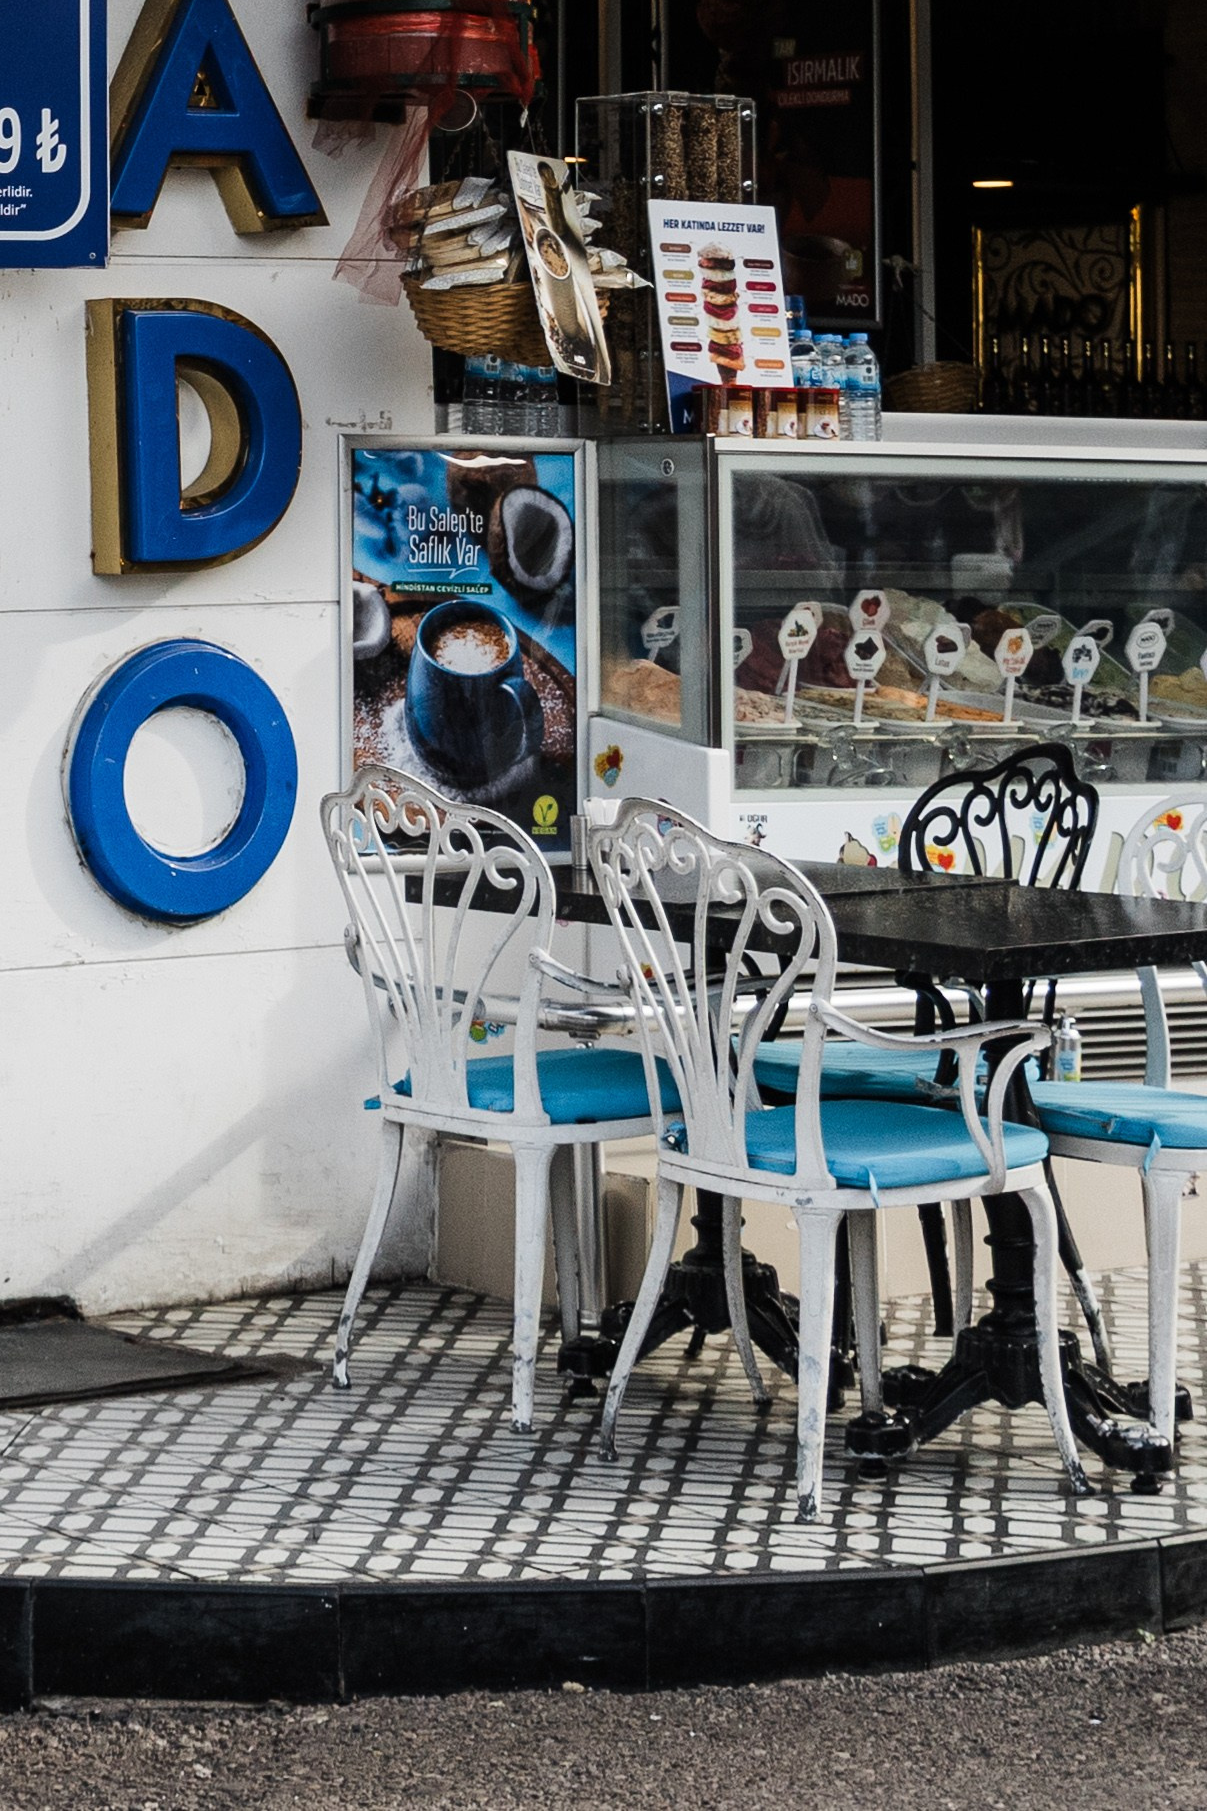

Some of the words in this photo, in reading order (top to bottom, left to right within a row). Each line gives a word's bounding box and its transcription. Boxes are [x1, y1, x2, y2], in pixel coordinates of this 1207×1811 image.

[787, 55, 860, 86] ISIRMALIK
[663, 219, 679, 229] HER
[681, 220, 716, 231] KATINDA
[717, 221, 745, 232] LEZZET
[746, 224, 765, 234] VAR!
[835, 294, 870, 307] MADO
[407, 505, 426, 531] Bu
[429, 506, 484, 539] Salep'te
[408, 534, 452, 565] Saflık
[456, 537, 482, 565] Var
[395, 582, 435, 592] HİNDİSTAN
[436, 584, 465, 593] CEVİZLİ
